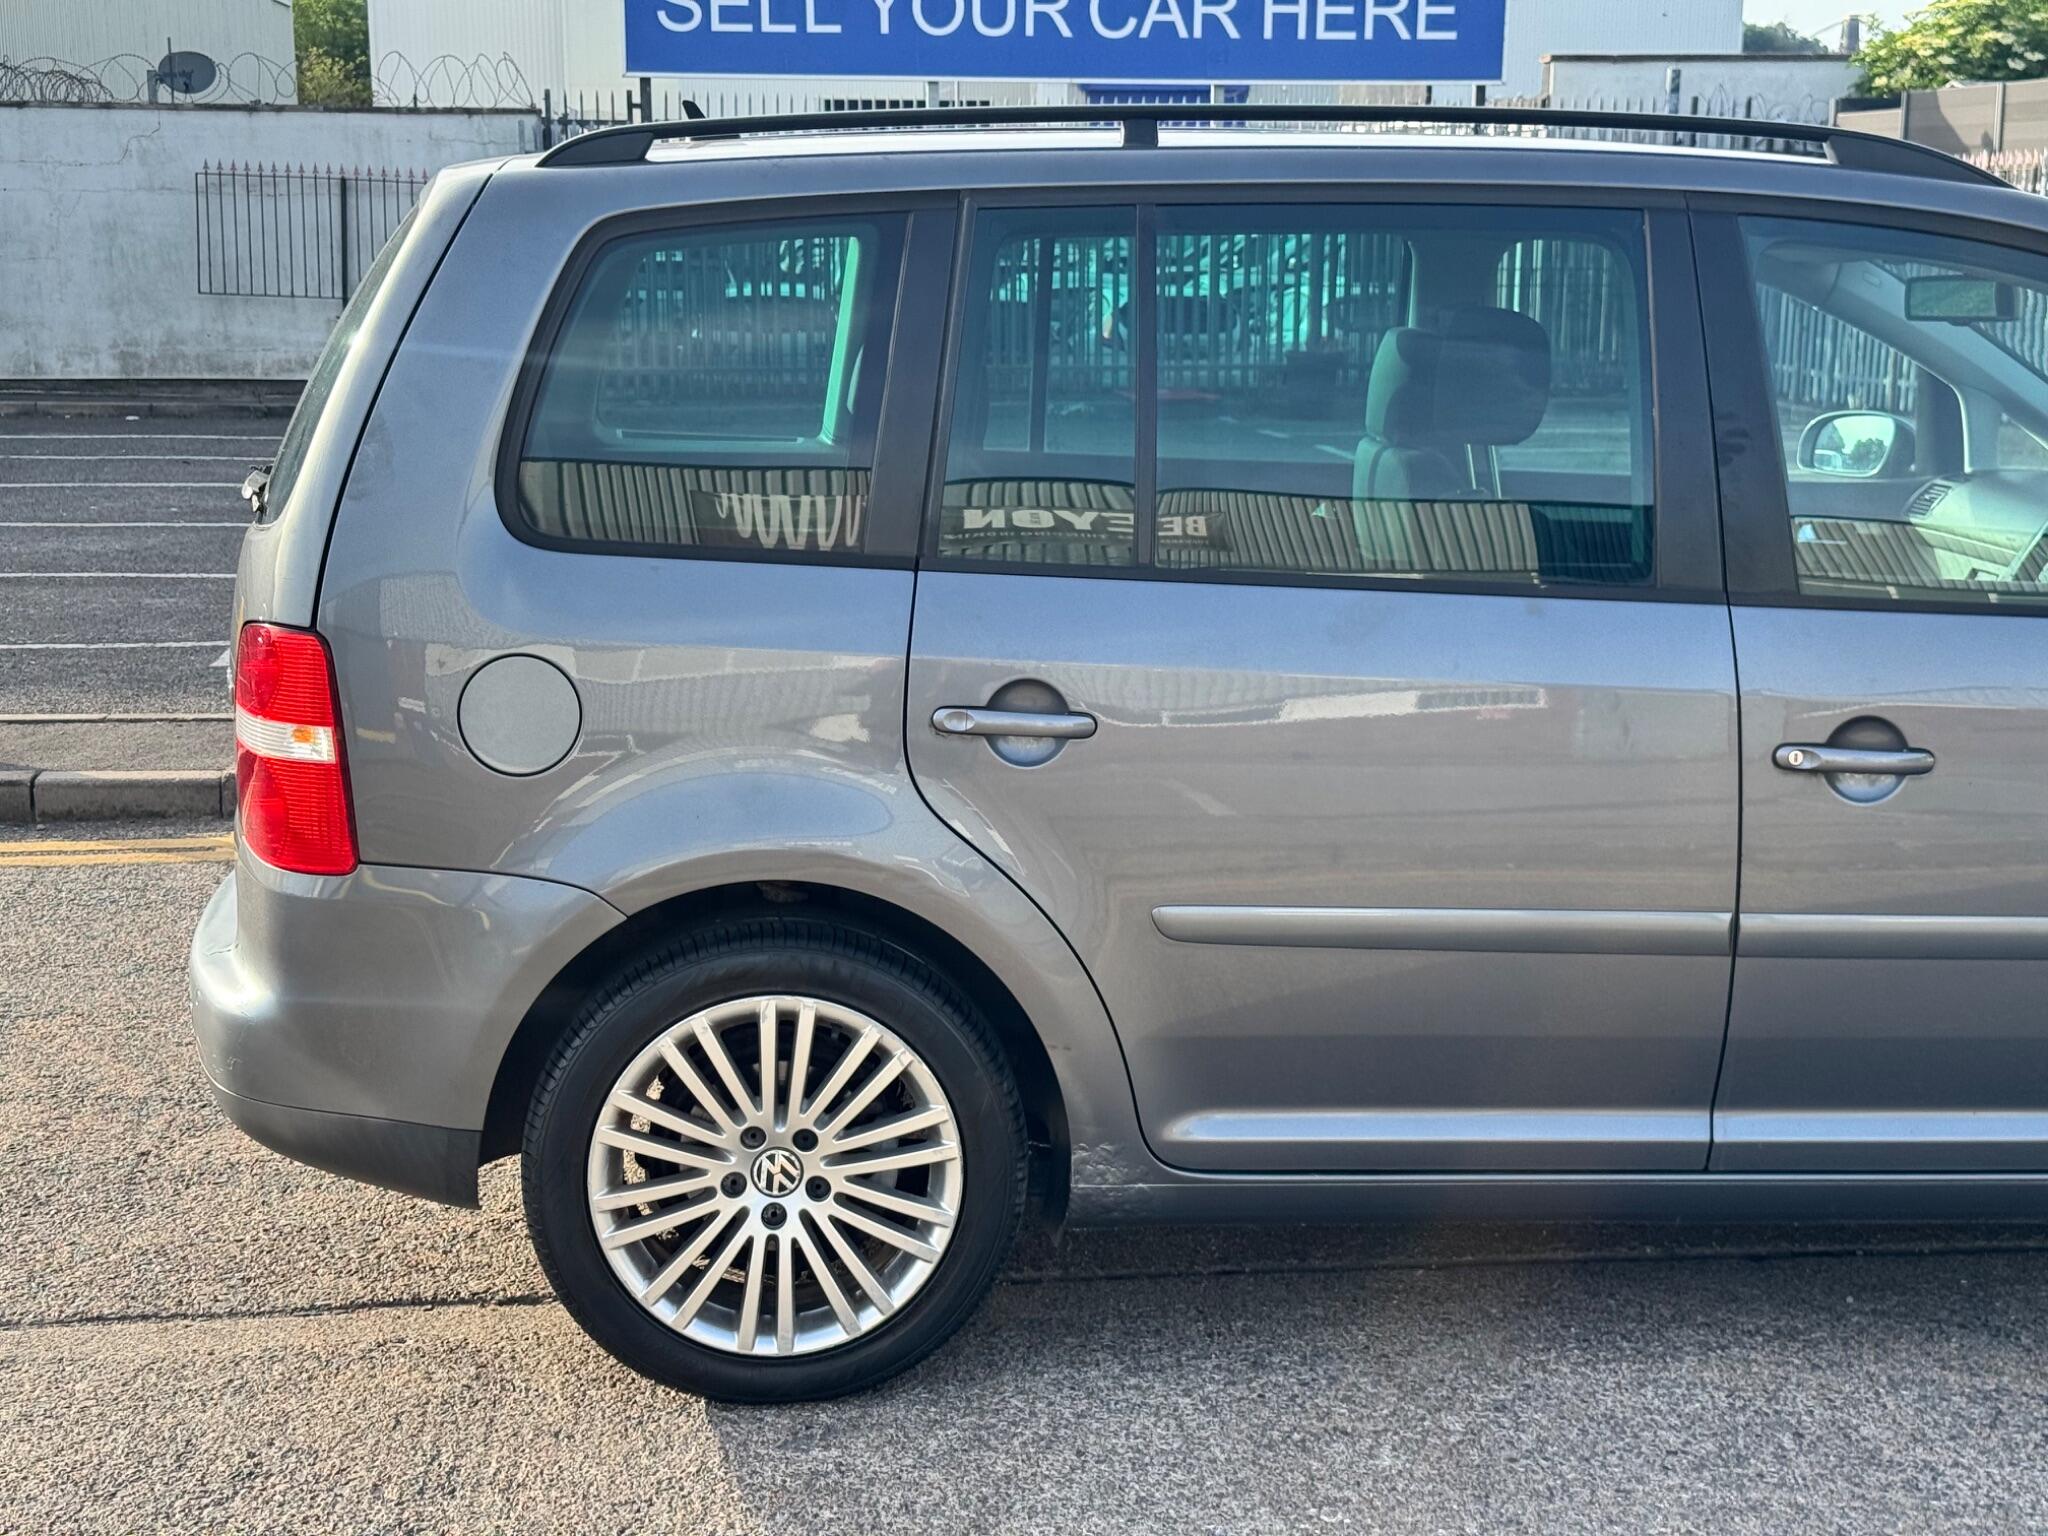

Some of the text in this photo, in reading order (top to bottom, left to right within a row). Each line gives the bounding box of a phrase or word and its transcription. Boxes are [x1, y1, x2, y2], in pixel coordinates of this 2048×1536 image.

[656, 0, 1458, 40] SELL YOUR CAR HERE
